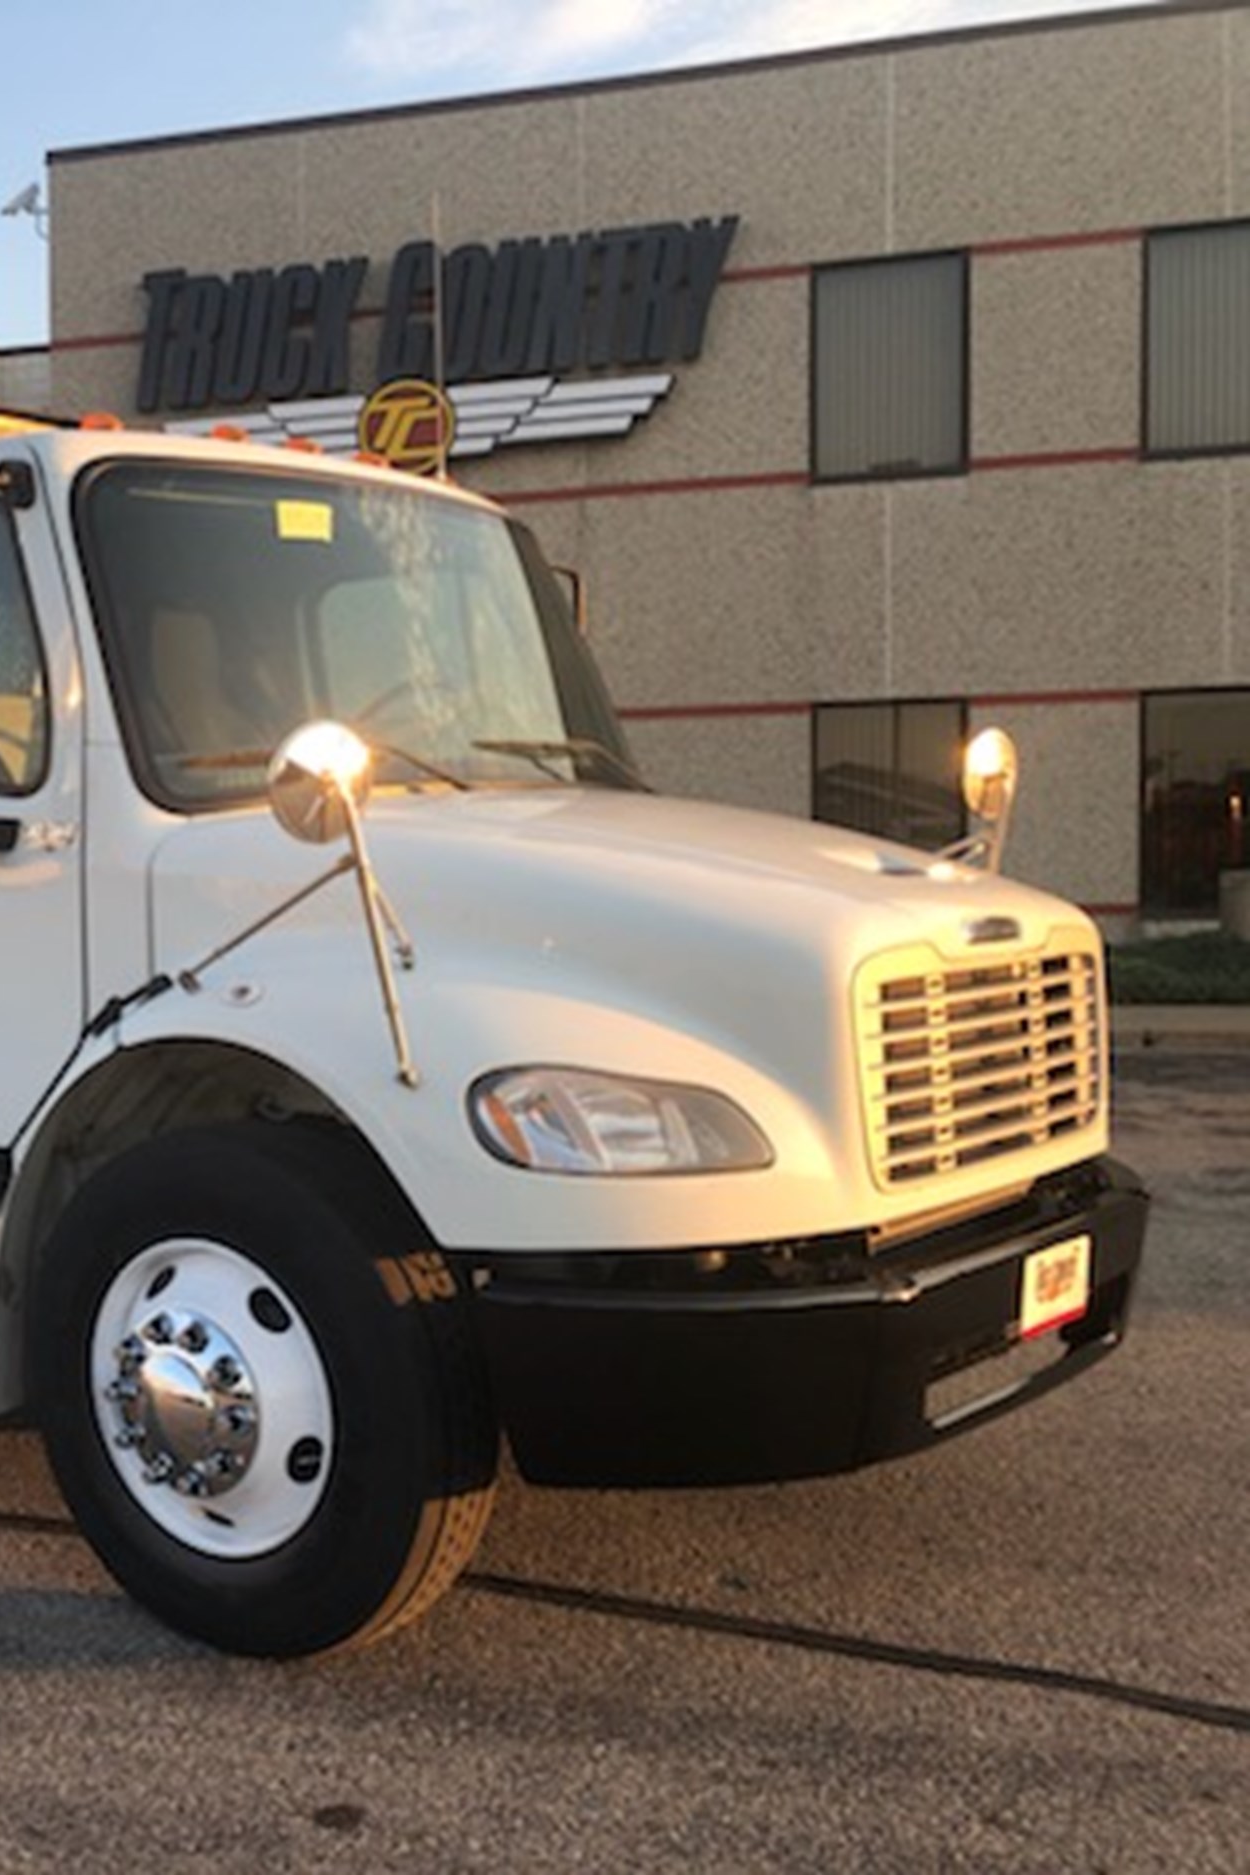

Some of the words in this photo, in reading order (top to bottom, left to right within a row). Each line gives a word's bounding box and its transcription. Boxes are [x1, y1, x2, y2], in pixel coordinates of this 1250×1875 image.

[136, 255, 369, 413] TRUCK
[376, 214, 739, 382] COUNTRY
[364, 397, 444, 458] TC
